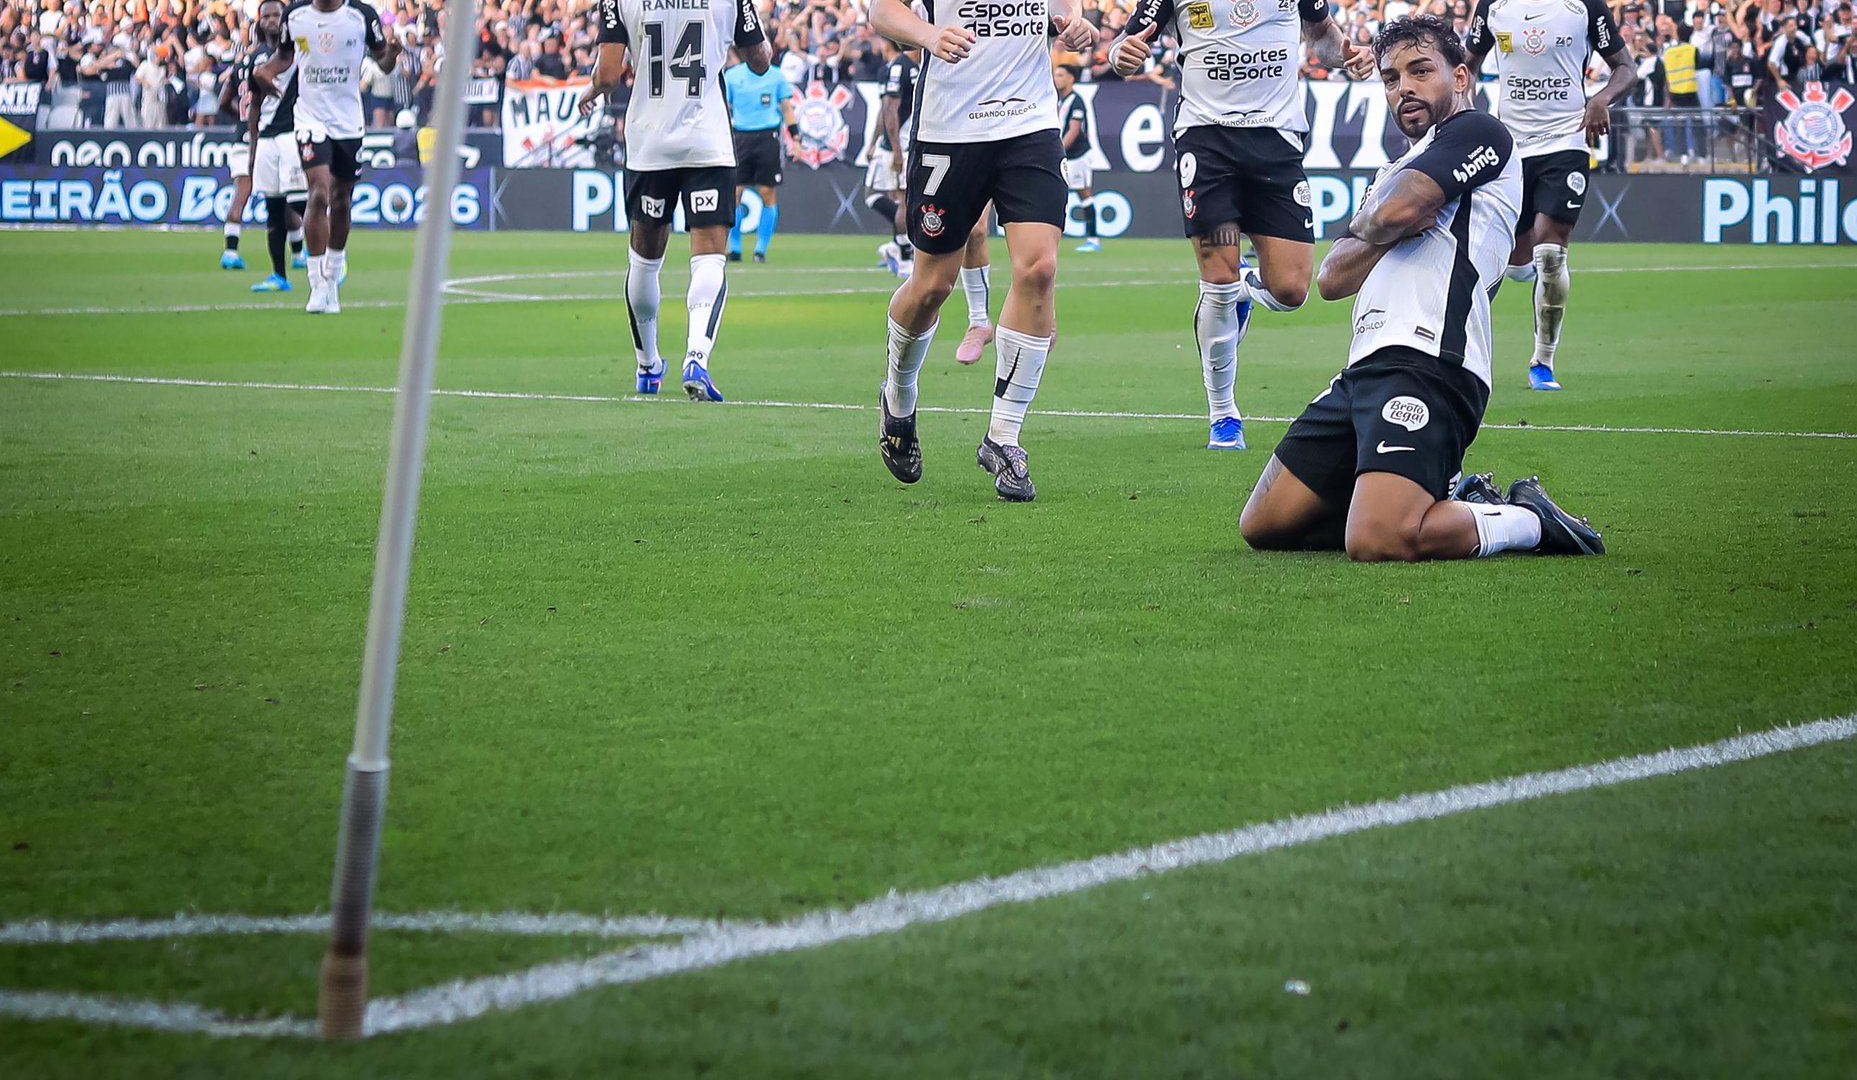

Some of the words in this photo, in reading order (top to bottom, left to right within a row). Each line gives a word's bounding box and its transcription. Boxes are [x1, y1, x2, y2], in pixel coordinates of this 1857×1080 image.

[742, 4, 757, 33] bmg
[957, 0, 1046, 22] Esportes
[640, 19, 708, 100] 14
[1202, 48, 1289, 69] Esportes
[1506, 75, 1572, 91] Esportes
[968, 109, 1006, 120] GERANDO
[1461, 145, 1501, 179] bmg
[921, 153, 951, 197] 7
[0, 169, 169, 222] EIRÃO
[695, 194, 714, 213] px
[645, 200, 663, 215] px
[1389, 400, 1425, 415] Broto
[1389, 410, 1425, 425] Legal
